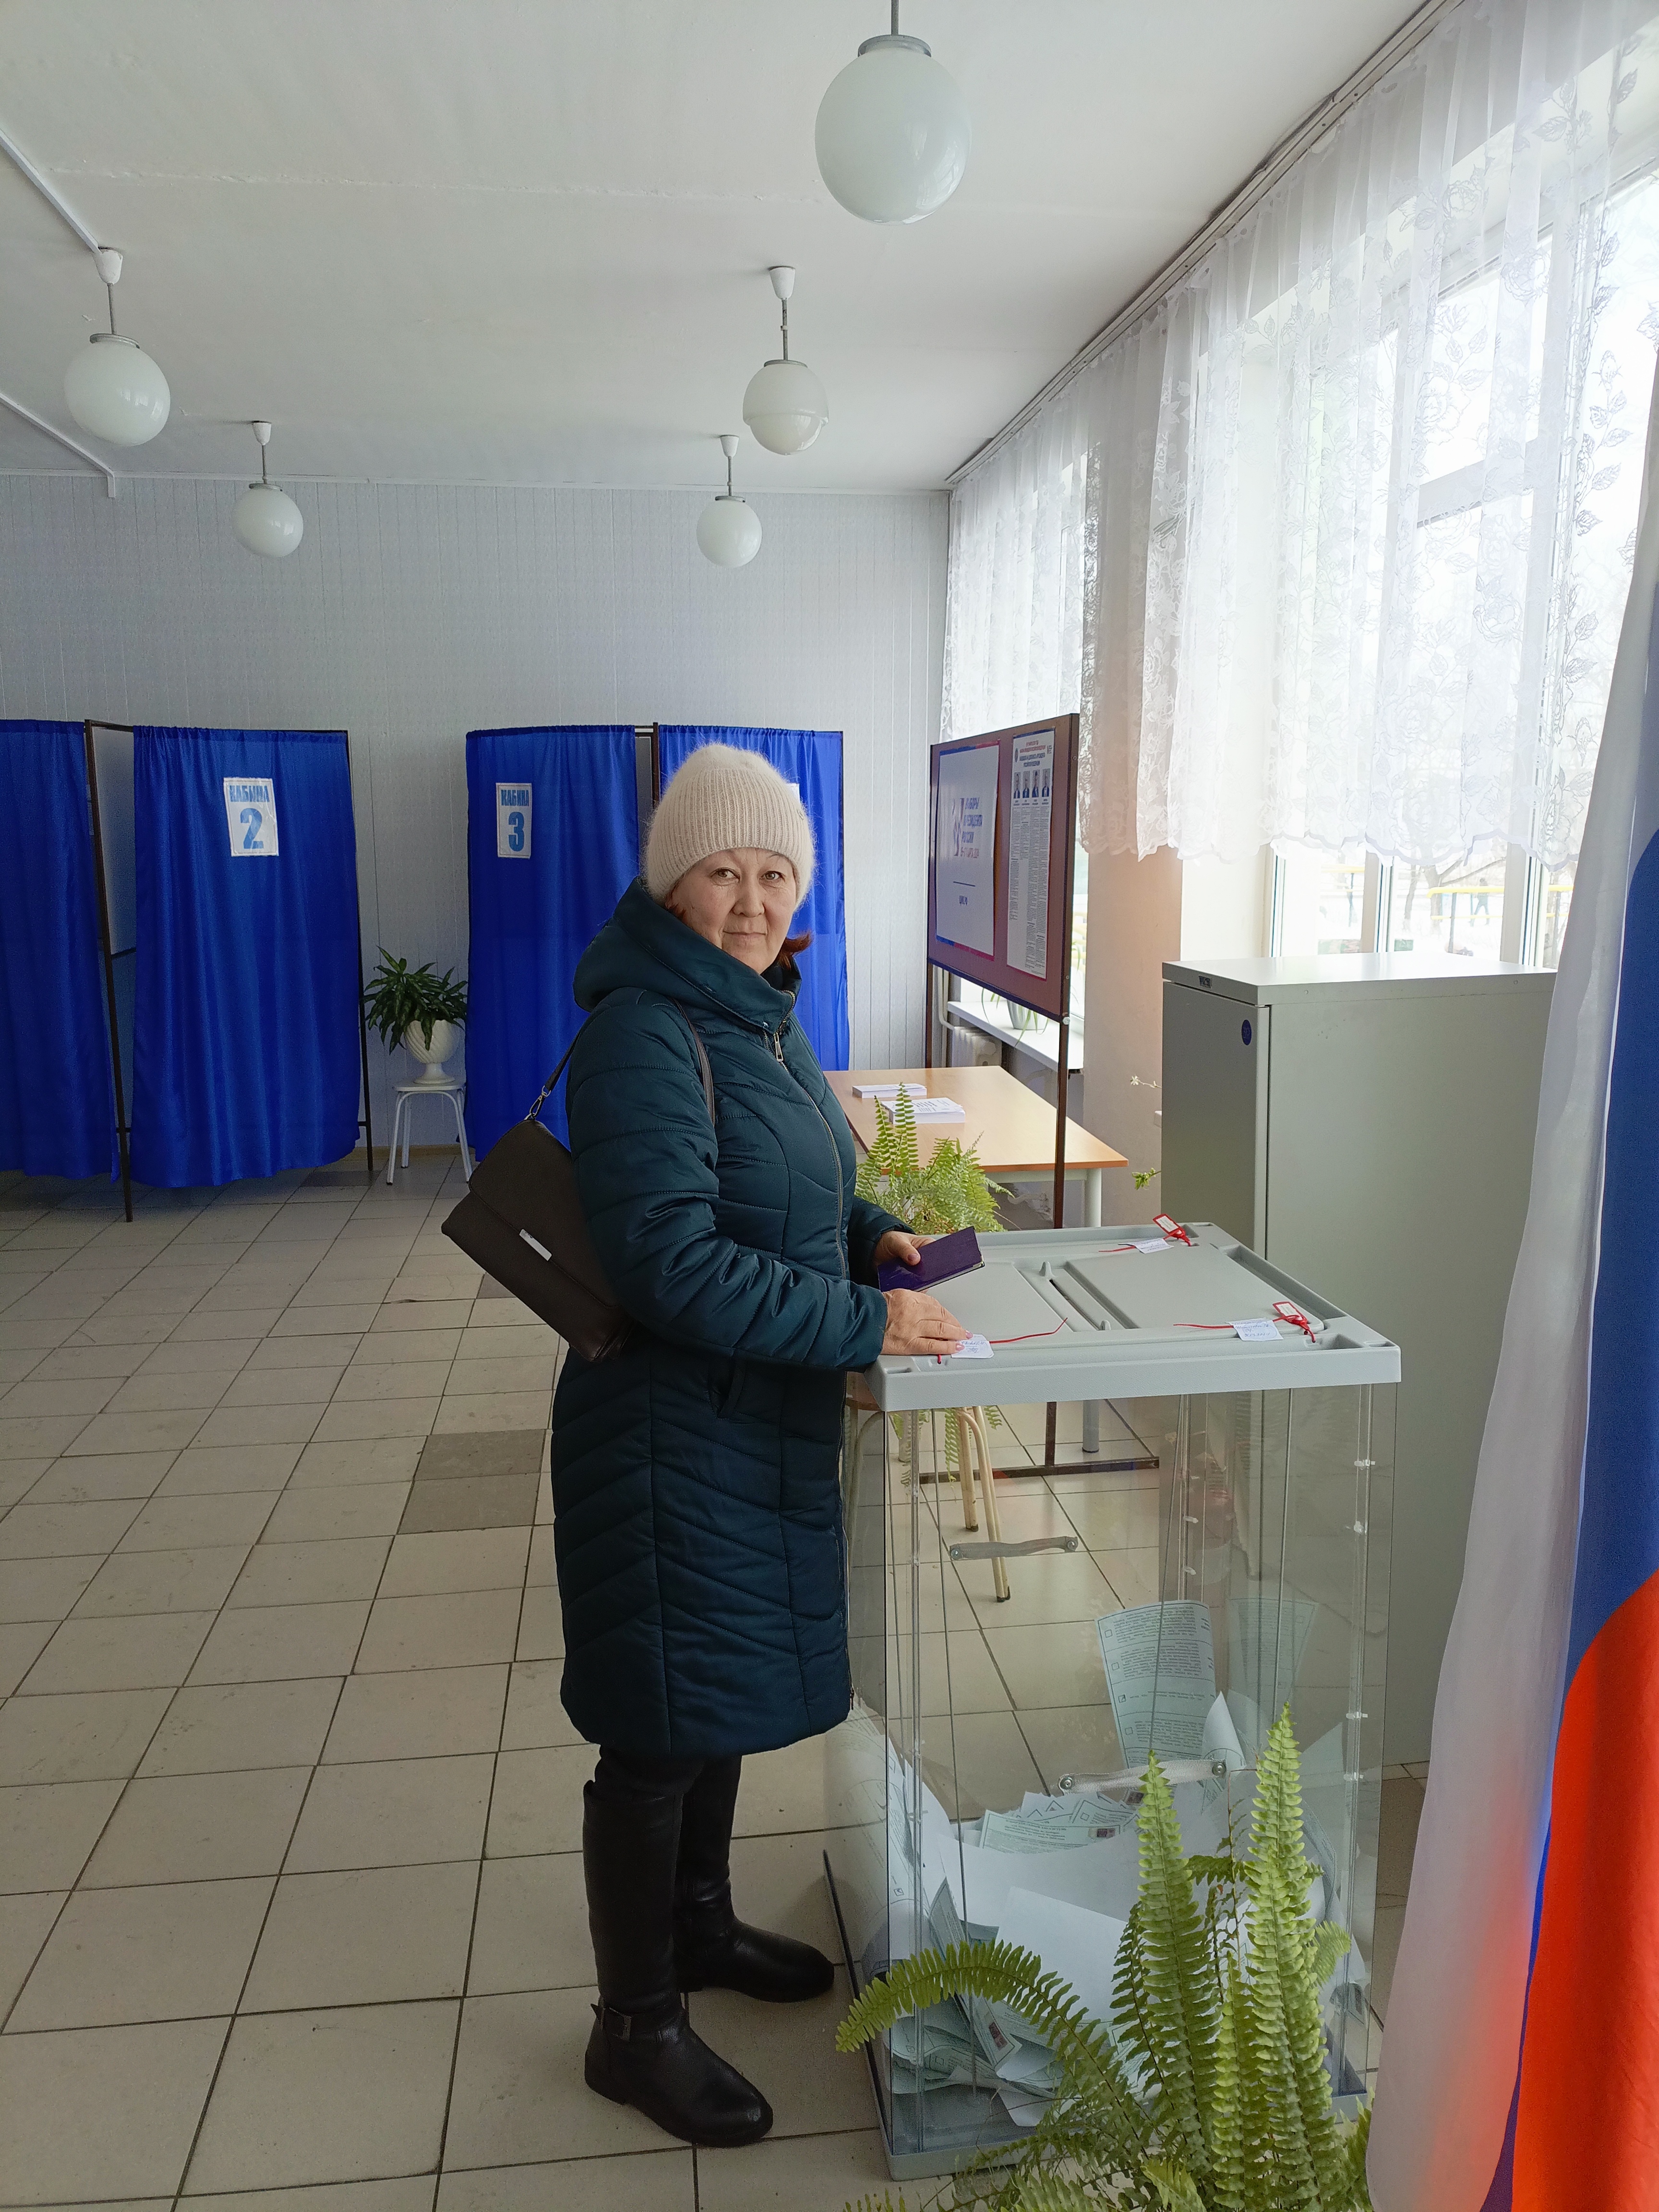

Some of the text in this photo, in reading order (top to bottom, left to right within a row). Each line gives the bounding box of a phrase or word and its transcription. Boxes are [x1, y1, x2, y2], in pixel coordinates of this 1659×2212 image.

[229, 785, 270, 803] КАБИНА
[501, 789, 529, 806] КАБИНА
[240, 807, 264, 849] 2
[508, 811, 525, 852] 3
